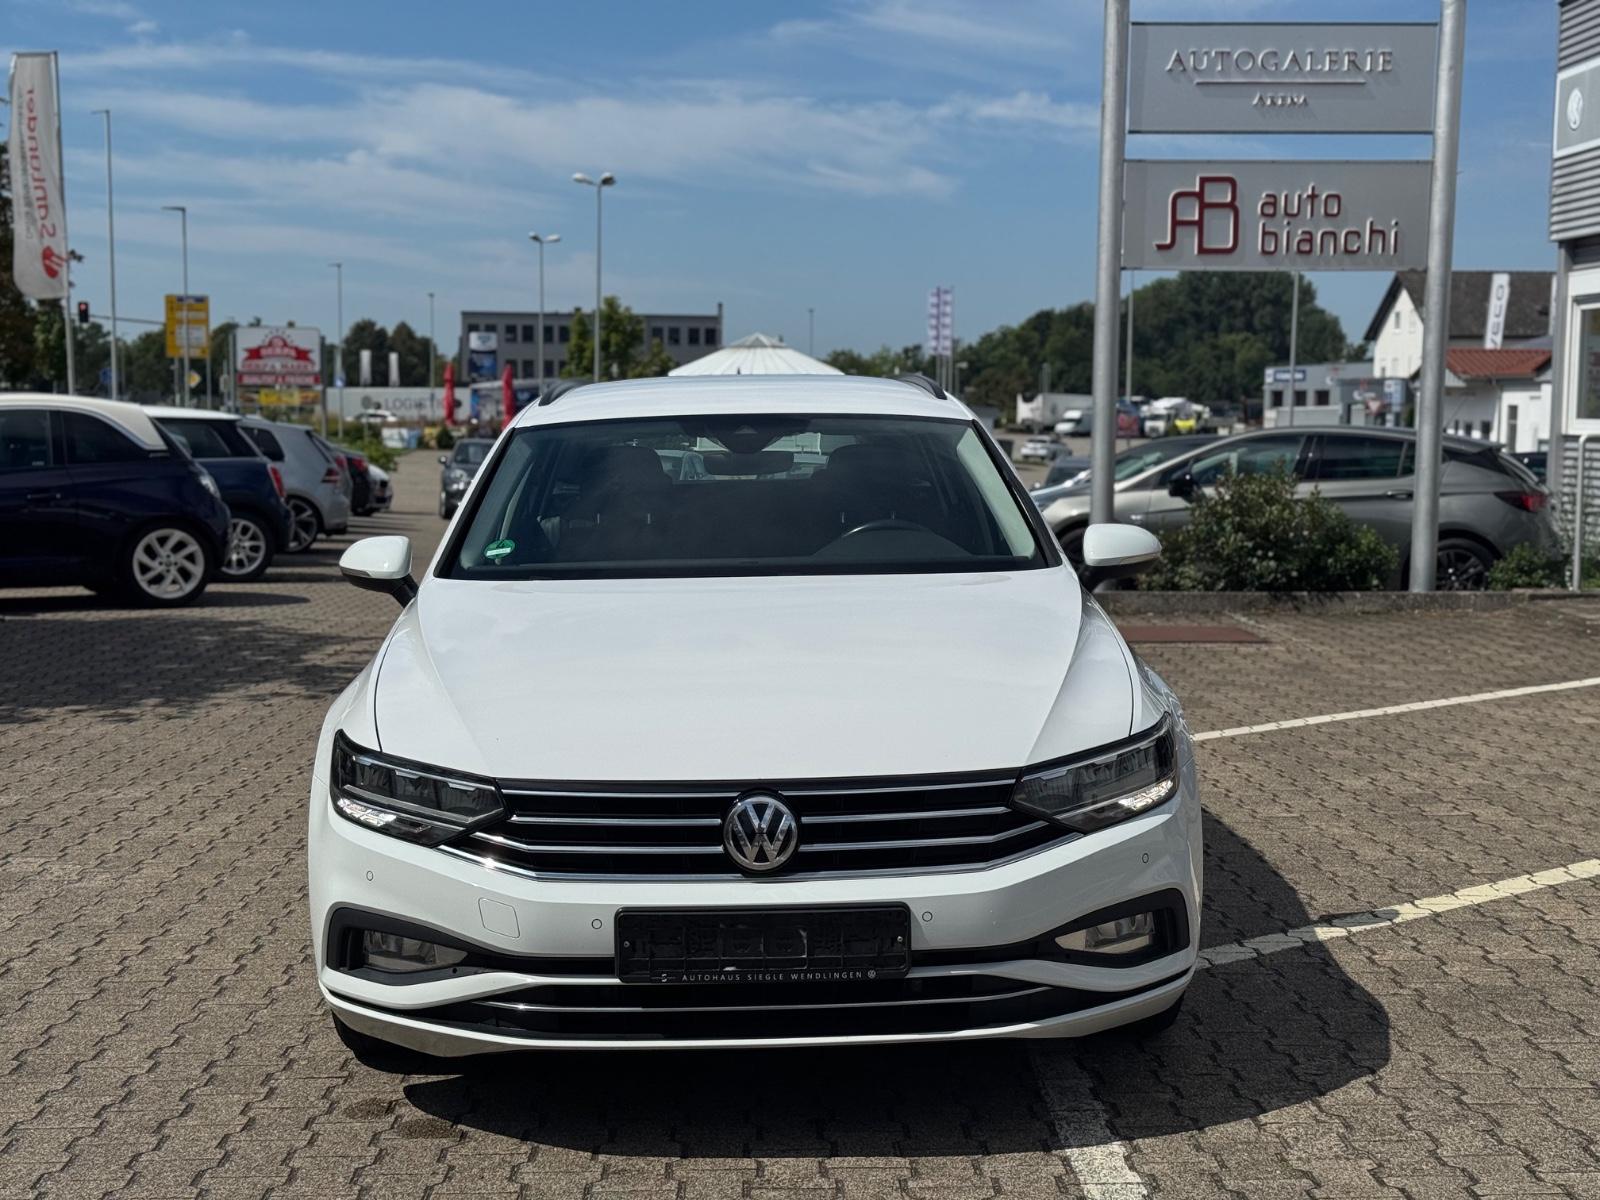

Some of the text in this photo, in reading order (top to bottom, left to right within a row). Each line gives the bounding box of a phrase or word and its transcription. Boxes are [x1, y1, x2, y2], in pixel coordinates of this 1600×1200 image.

[1164, 48, 1394, 73] AUTOGALERIE
[1257, 181, 1342, 219] auto
[1258, 217, 1400, 256] bianchi
[682, 974, 741, 982] AUTOHAUS
[747, 973, 785, 981] SIEGLE
[790, 970, 863, 981] WENDLINGEN
